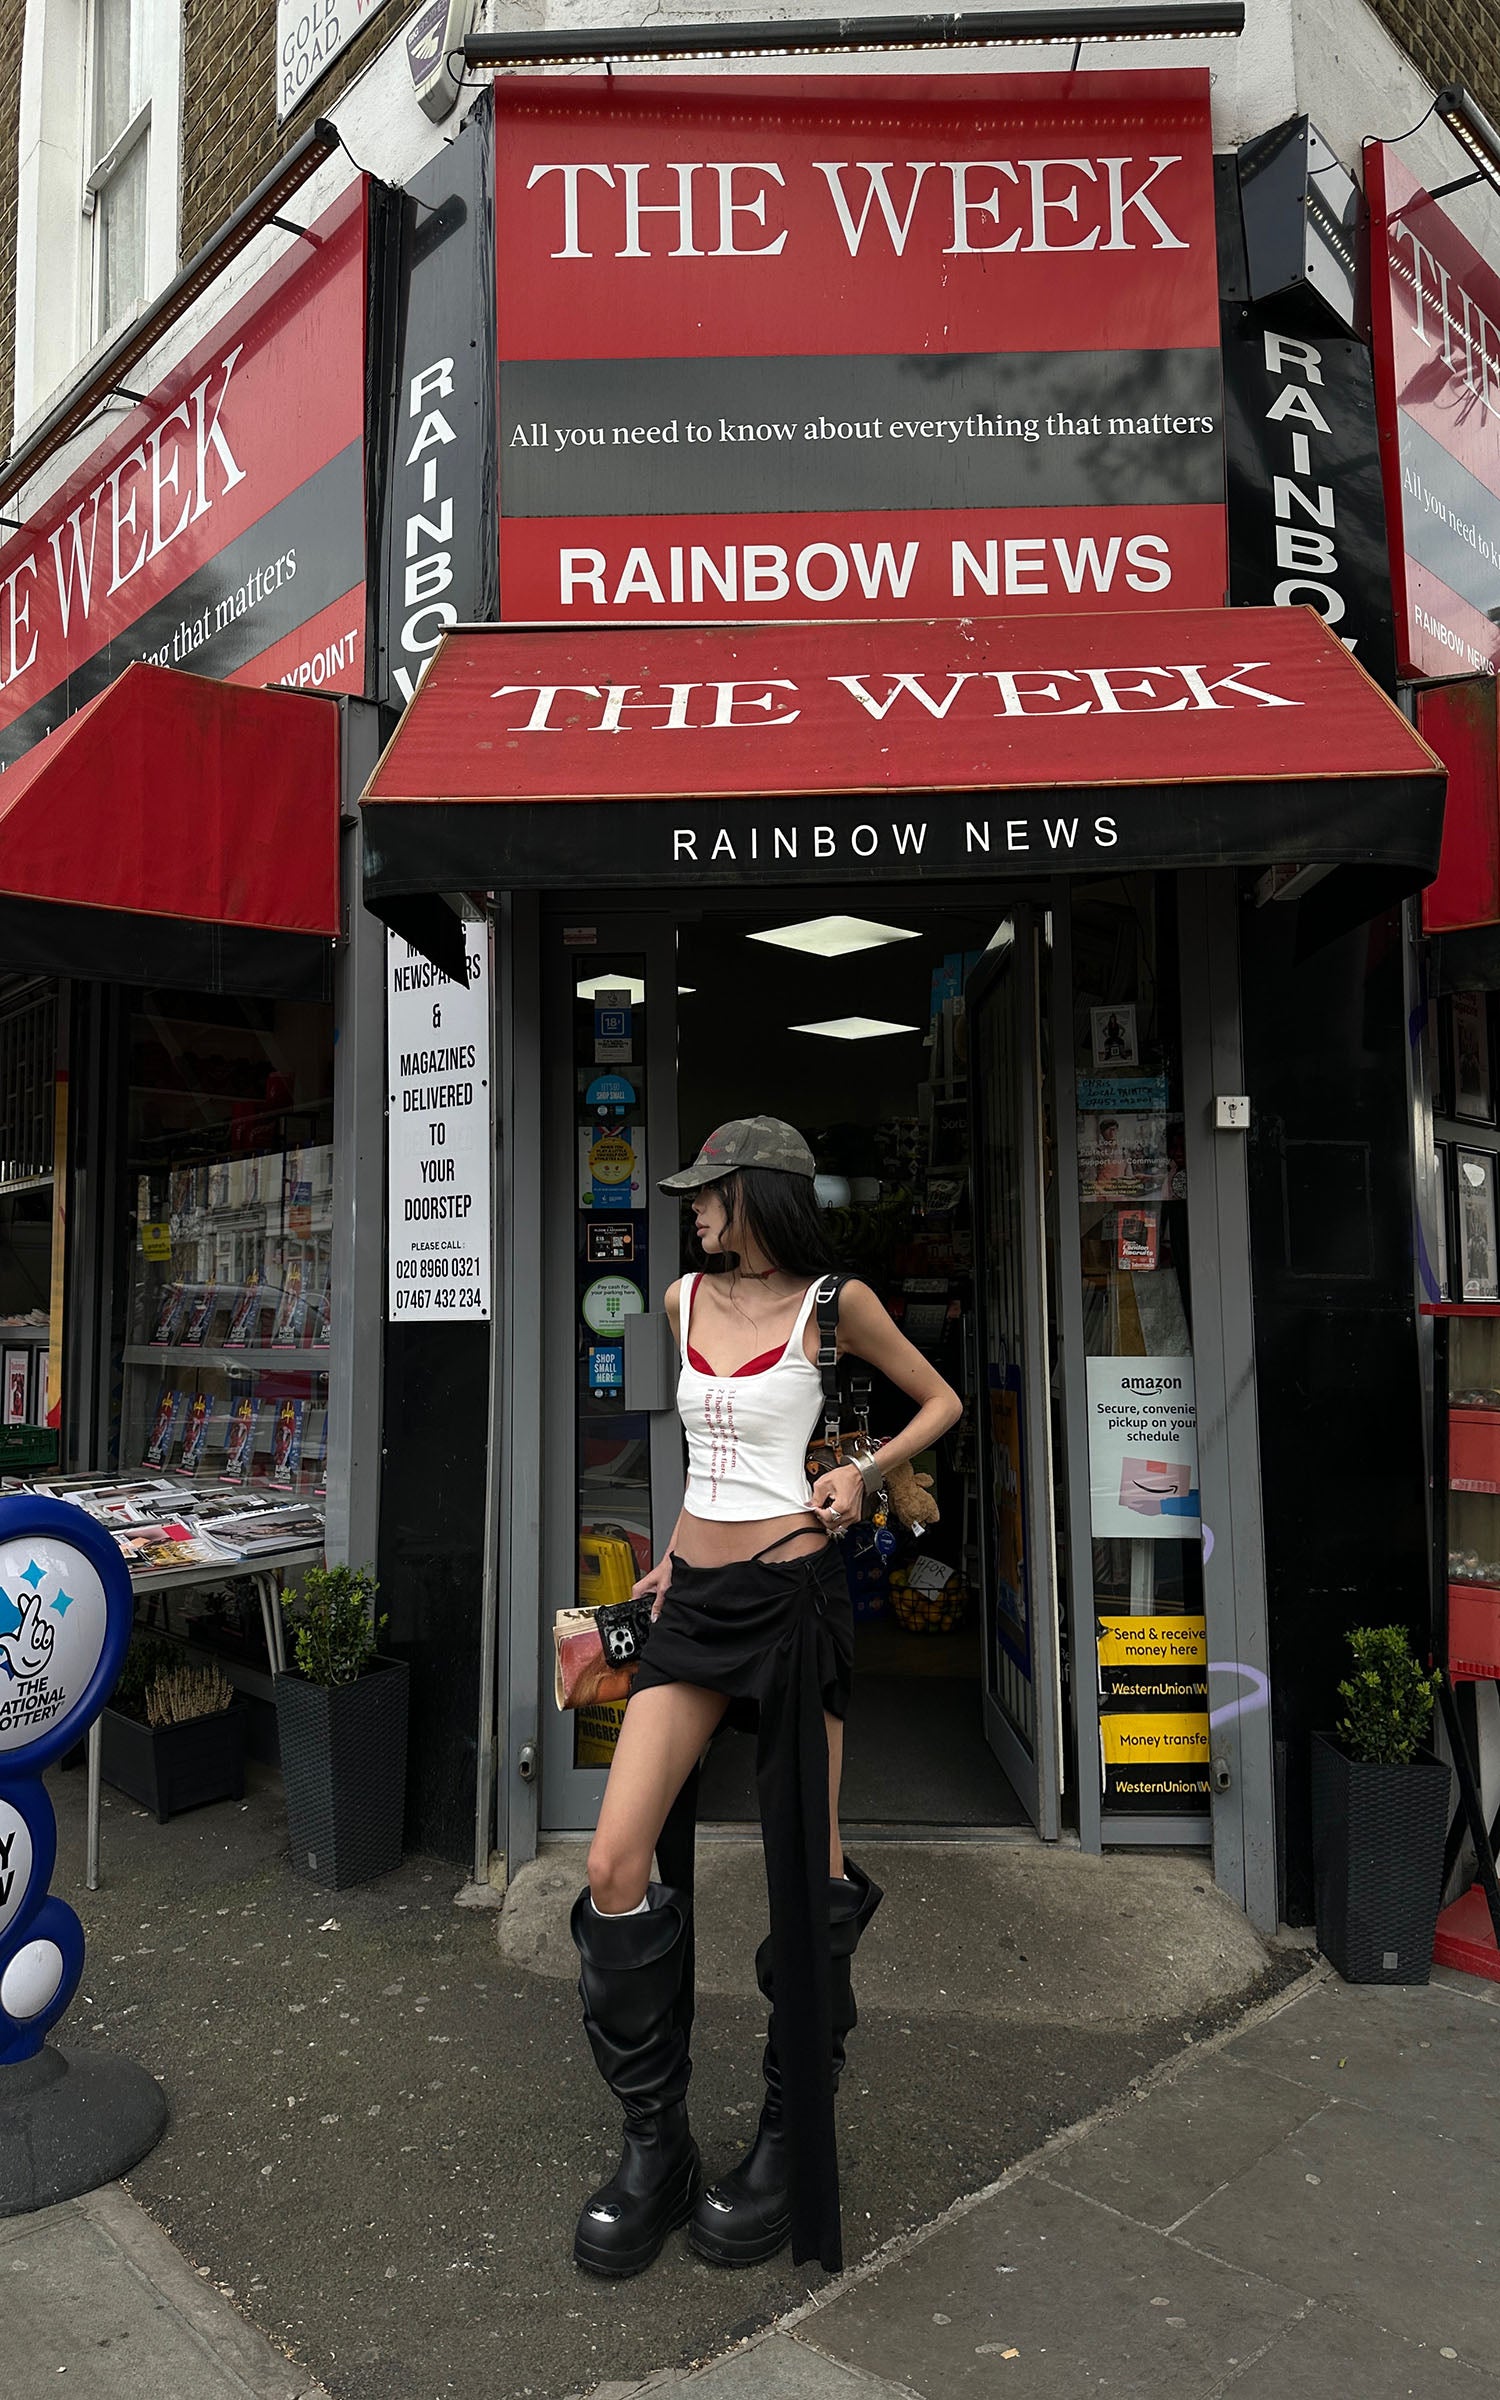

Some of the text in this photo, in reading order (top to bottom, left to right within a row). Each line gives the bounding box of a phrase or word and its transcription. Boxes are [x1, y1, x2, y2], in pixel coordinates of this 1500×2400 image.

[526, 156, 1190, 259] THE WEEK
[509, 413, 1214, 452] All you need to know about everything that matters
[47, 343, 247, 640] WEEK
[1264, 330, 1357, 656] RAINBO
[1404, 467, 1421, 501] All
[1424, 487, 1446, 523] you
[1448, 510, 1476, 550] need
[1478, 536, 1489, 560] to
[560, 535, 1172, 605] RAINBOW NEWS
[173, 607, 212, 662] that
[215, 548, 296, 633] matters
[1414, 603, 1494, 676] RAINBOW NEWS
[490, 662, 1305, 732] THE WEEK
[673, 816, 1118, 860] RAINBOW NEWS
[432, 1003, 441, 1028] &
[400, 1044, 475, 1077] MAGAZINES
[403, 1082, 473, 1113] DELIVERED
[429, 1122, 446, 1146] TO
[420, 1158, 455, 1183] YOUR
[1080, 1158, 1111, 1167] Support
[1126, 1157, 1171, 1166] Community
[404, 1194, 472, 1221] DOORSTEP
[411, 1241, 440, 1251] PLEASE
[396, 1257, 480, 1279] 020 8960 0321
[396, 1287, 481, 1309] 07467 432 234
[594, 1363, 617, 1373] SMALL
[595, 1353, 616, 1364] SHOP
[596, 1372, 615, 1383] HERE
[1121, 1377, 1182, 1389] amazon
[1097, 1403, 1140, 1415] Secure,
[1108, 1417, 1148, 1430] pickup
[1152, 1418, 1167, 1428] on
[1127, 1431, 1180, 1442] schedule
[1115, 1628, 1206, 1640] Send & receive
[1125, 1643, 1198, 1657] money here
[17, 1676, 48, 1697] THE
[1111, 1682, 1193, 1695] WesternUnion
[1120, 1734, 1160, 1748] Money
[1116, 1780, 1197, 1793] WesternUnion
